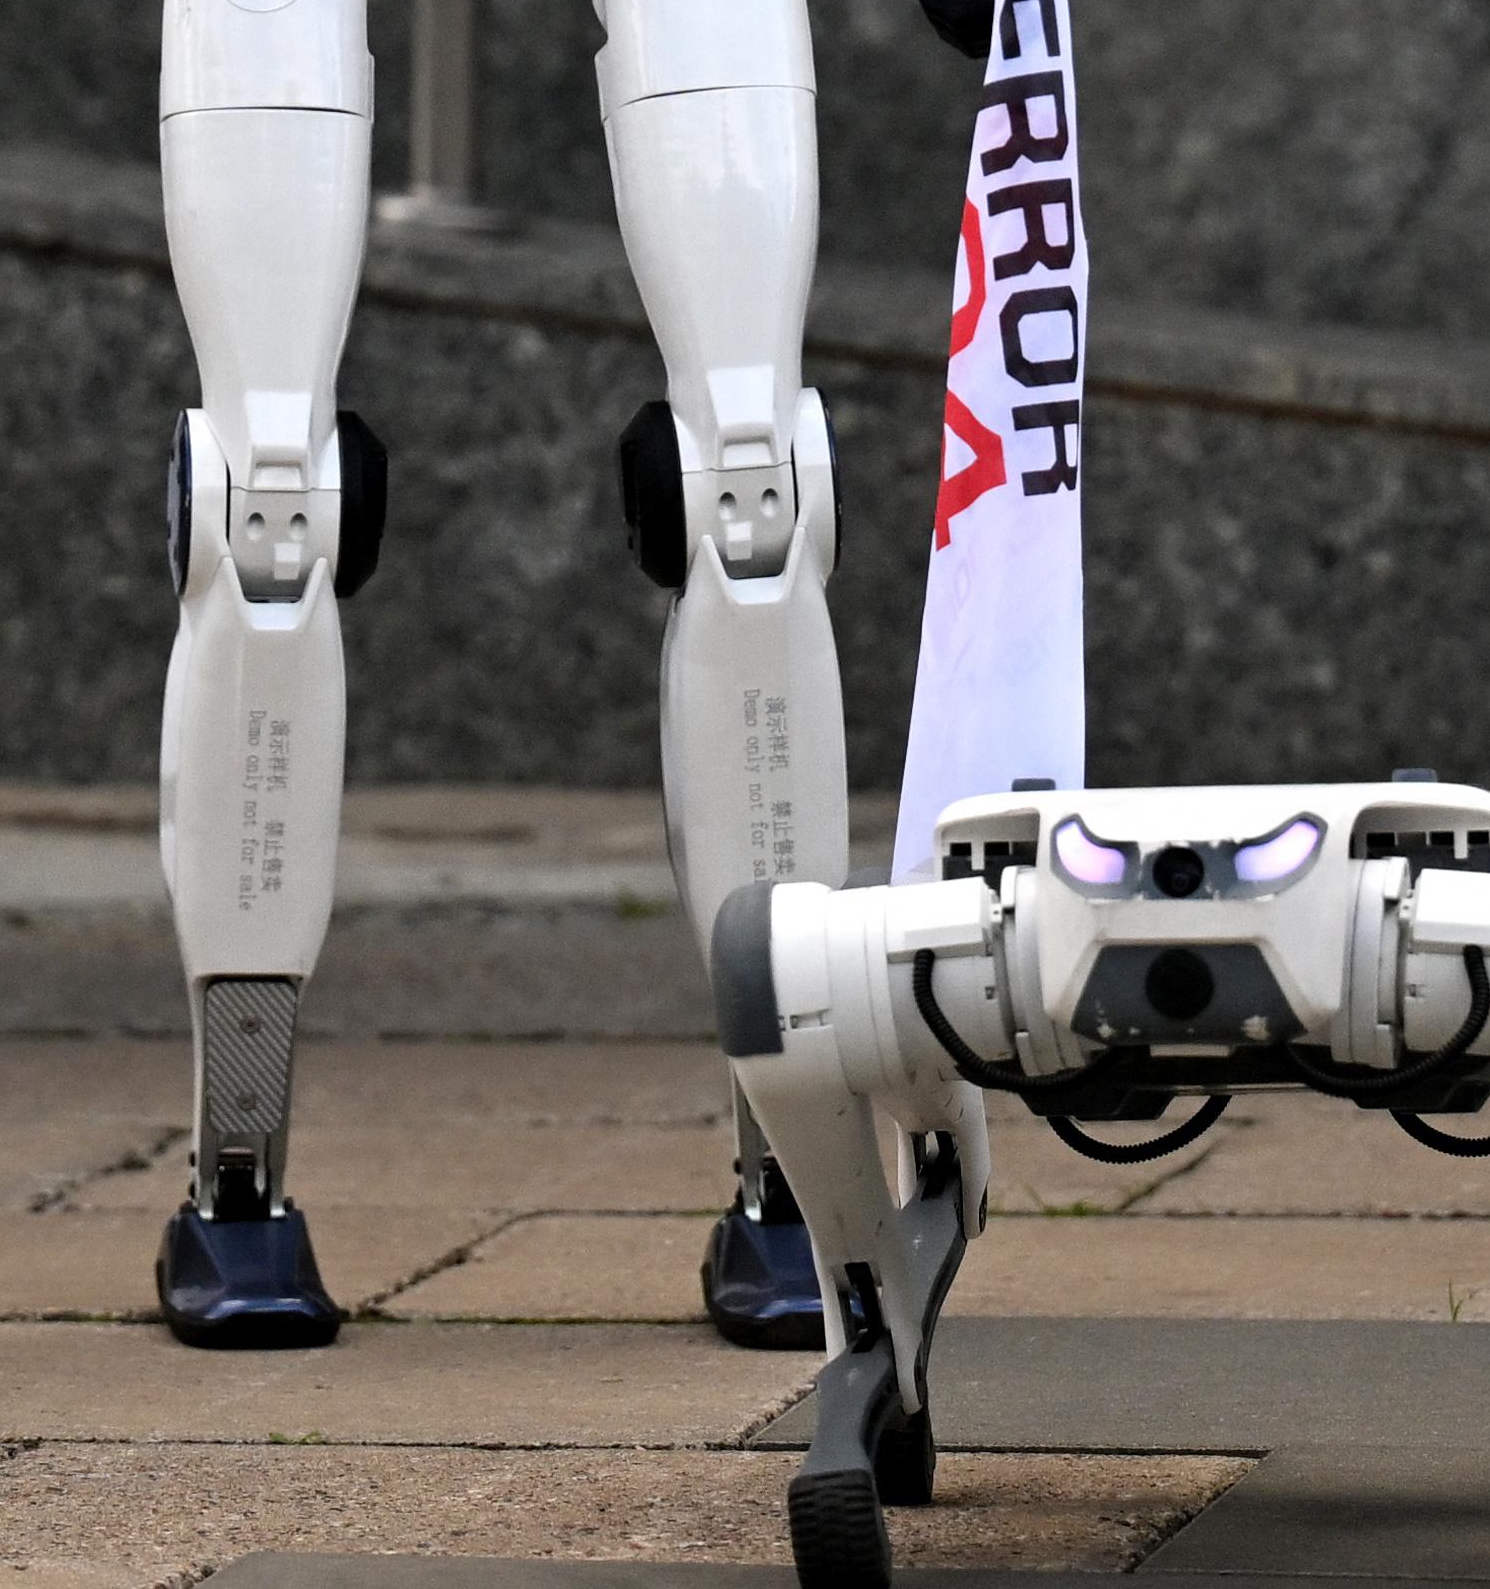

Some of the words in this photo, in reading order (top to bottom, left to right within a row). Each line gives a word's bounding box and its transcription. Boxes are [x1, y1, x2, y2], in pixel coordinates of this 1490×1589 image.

[744, 689, 760, 727] Demo
[248, 710, 267, 746] Demo
[765, 697, 790, 772] 演示样机
[744, 736, 766, 773] only
[243, 755, 263, 791] only
[243, 801, 257, 827] not
[749, 783, 763, 811] not
[240, 838, 259, 865] for
[751, 821, 769, 849] for
[238, 875, 258, 911] sale
